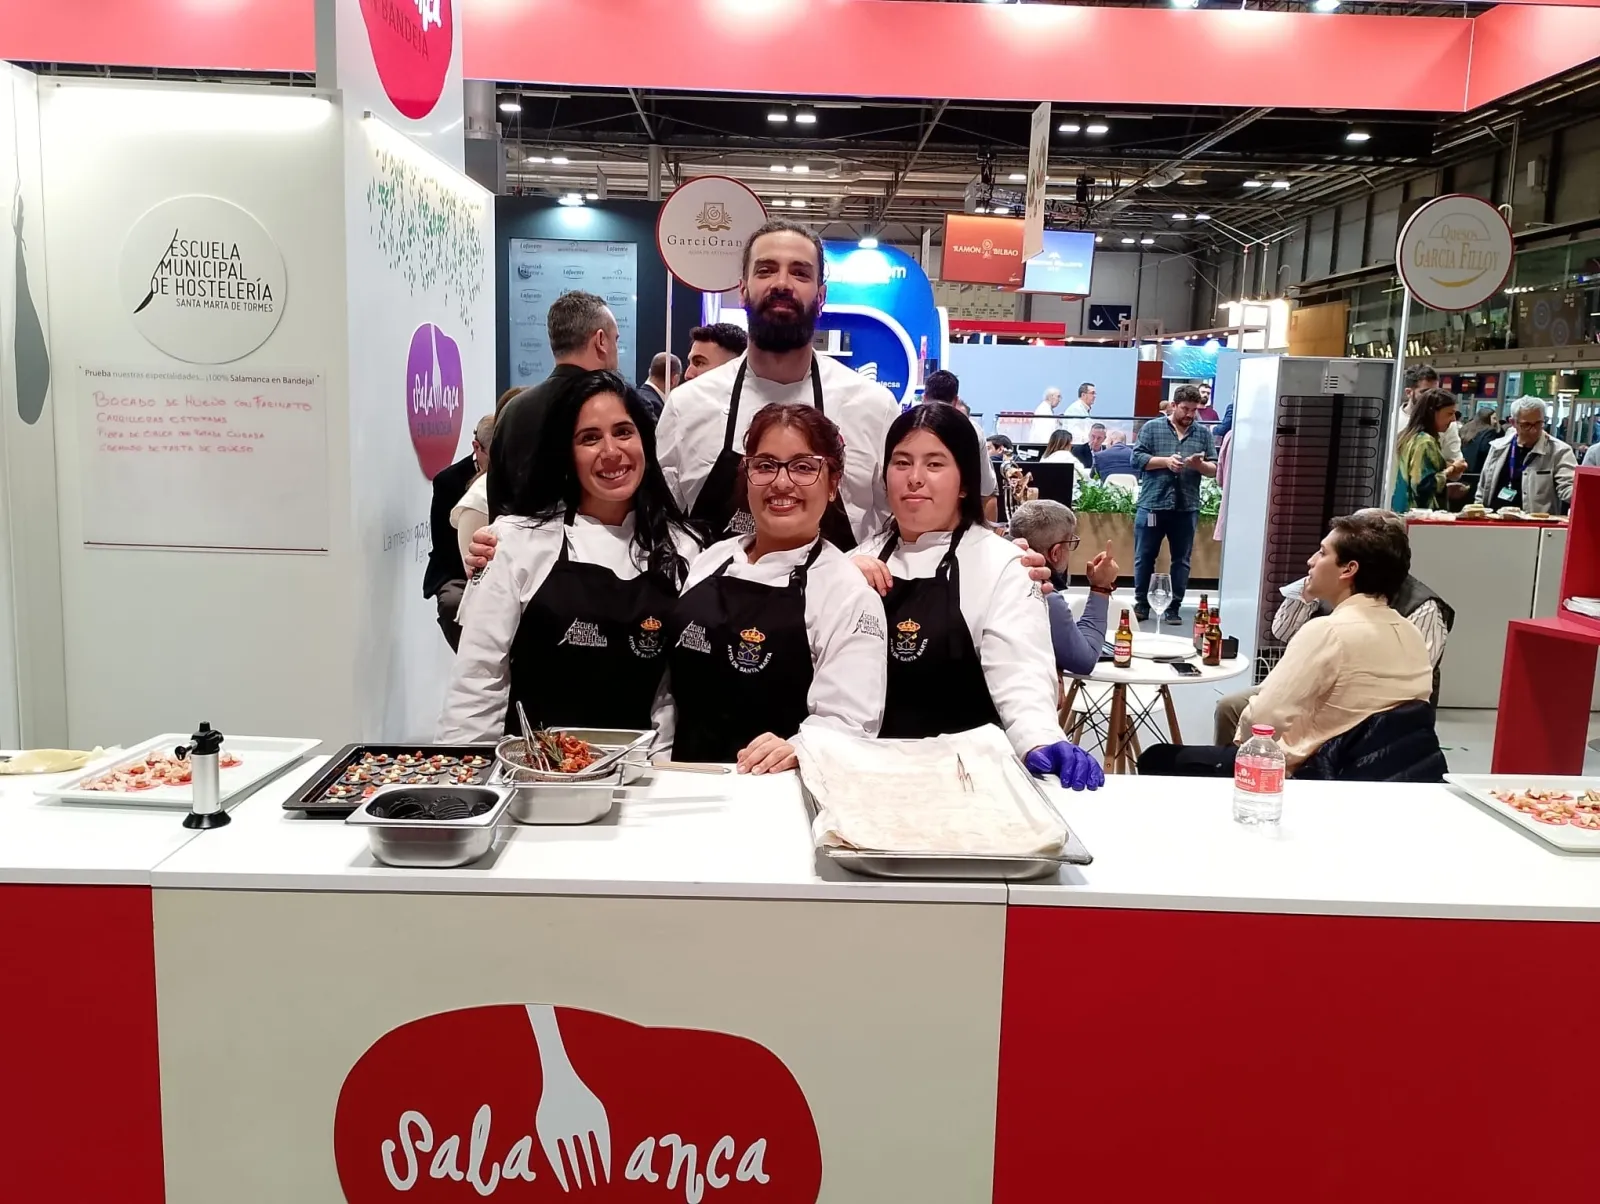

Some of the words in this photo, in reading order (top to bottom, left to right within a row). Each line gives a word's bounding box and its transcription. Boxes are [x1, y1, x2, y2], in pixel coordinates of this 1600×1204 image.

[170, 239, 241, 261] ESCUELA
[667, 234, 743, 247] GarciGran
[952, 245, 981, 254] RAMÓN
[992, 248, 1019, 256] BILBAO
[160, 258, 247, 281] MUNICIPAL
[151, 277, 169, 295] DE
[176, 278, 273, 301] HOSTELERÍA
[176, 298, 202, 308] SANTA
[203, 299, 230, 310] MARTA
[231, 301, 241, 311] DE
[243, 302, 274, 313] TORMES
[85, 369, 111, 377] Prueba
[112, 371, 145, 379] nuestras
[230, 374, 270, 384] Salamanca
[282, 376, 315, 387] Bandeja!
[92, 390, 157, 407] BOCADO
[165, 398, 179, 407] DE
[383, 532, 392, 552] La
[731, 660, 739, 669] DE
[739, 666, 760, 674] SANTA
[758, 652, 773, 670] MARTA
[381, 1103, 771, 1204] Salamanca
